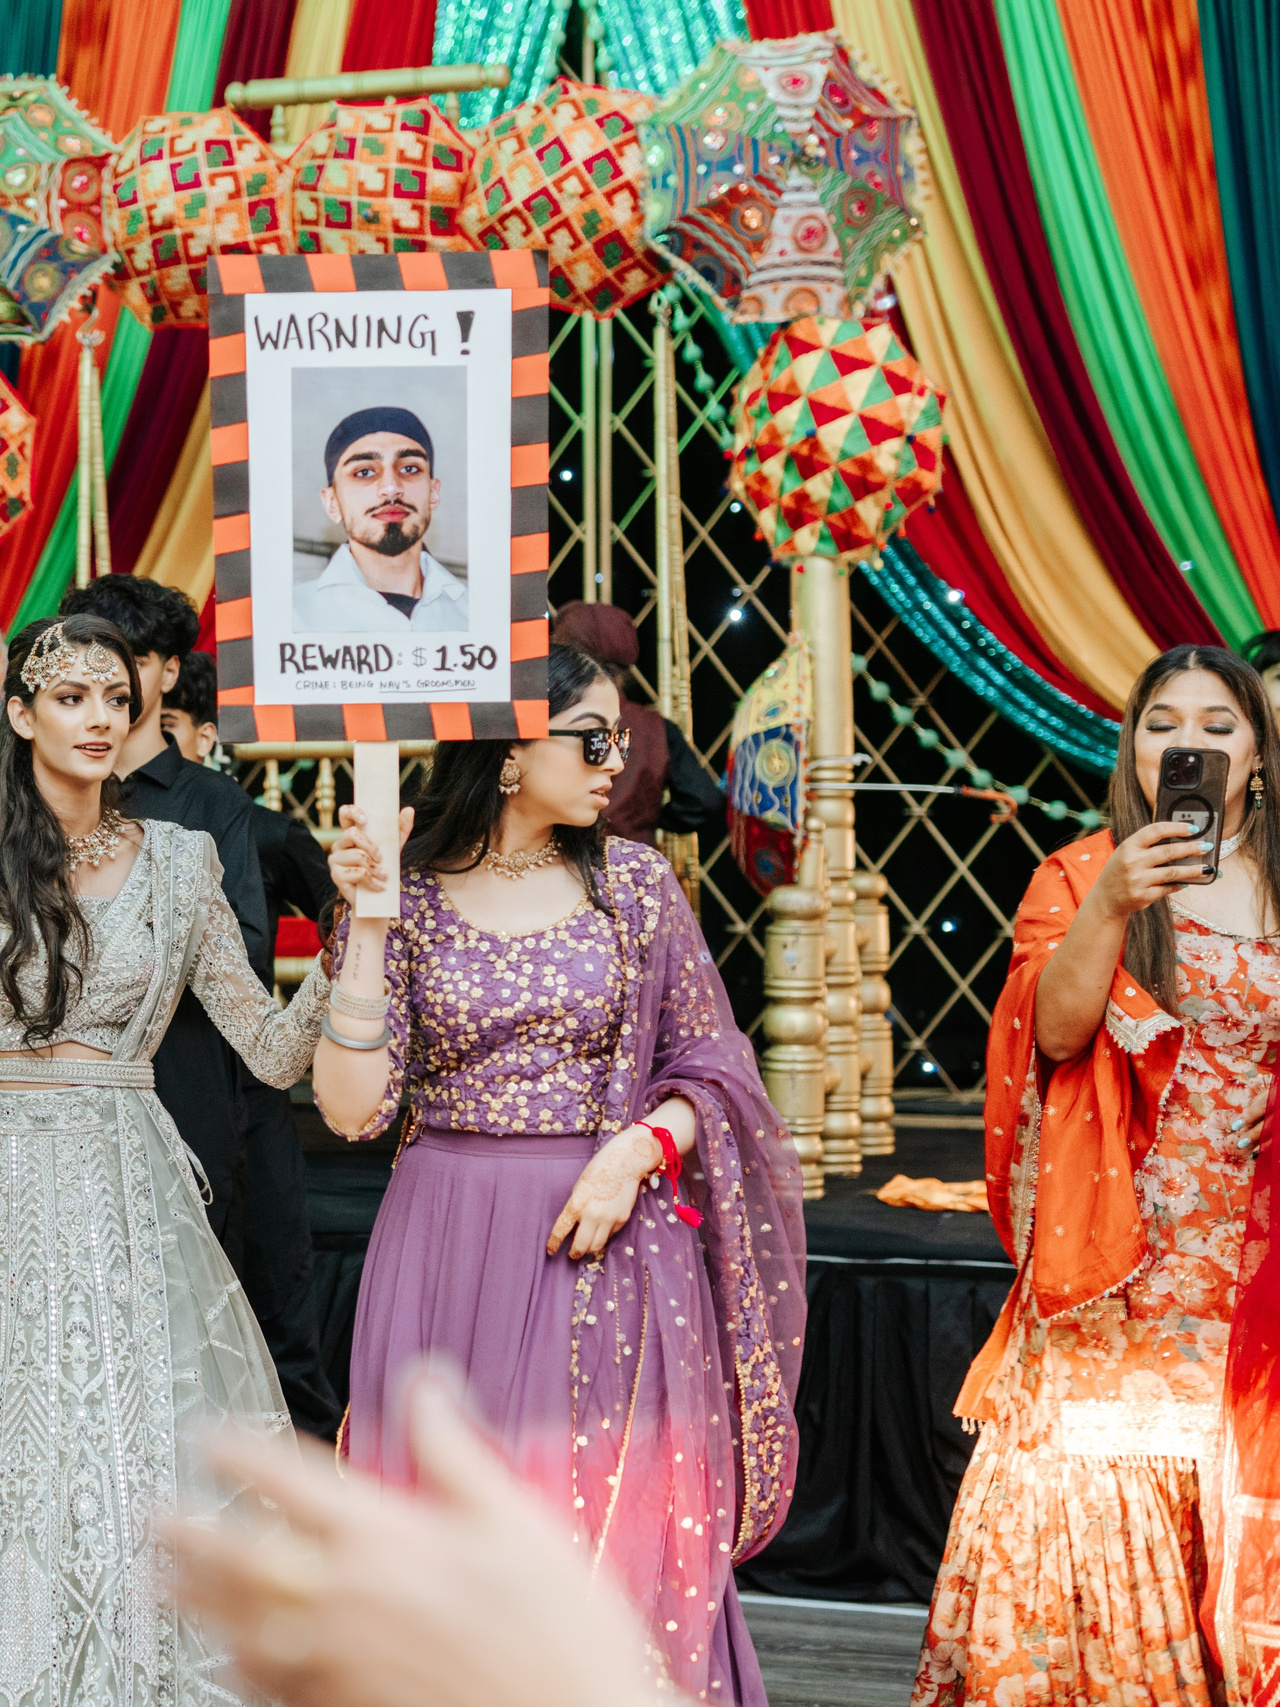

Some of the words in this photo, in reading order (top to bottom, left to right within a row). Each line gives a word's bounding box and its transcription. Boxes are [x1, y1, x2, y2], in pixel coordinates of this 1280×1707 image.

[295, 679, 337, 691] CRIME:
[340, 679, 374, 690] BEING
[379, 680, 411, 691] NAV'S
[416, 678, 477, 690] GROOMSMEN
